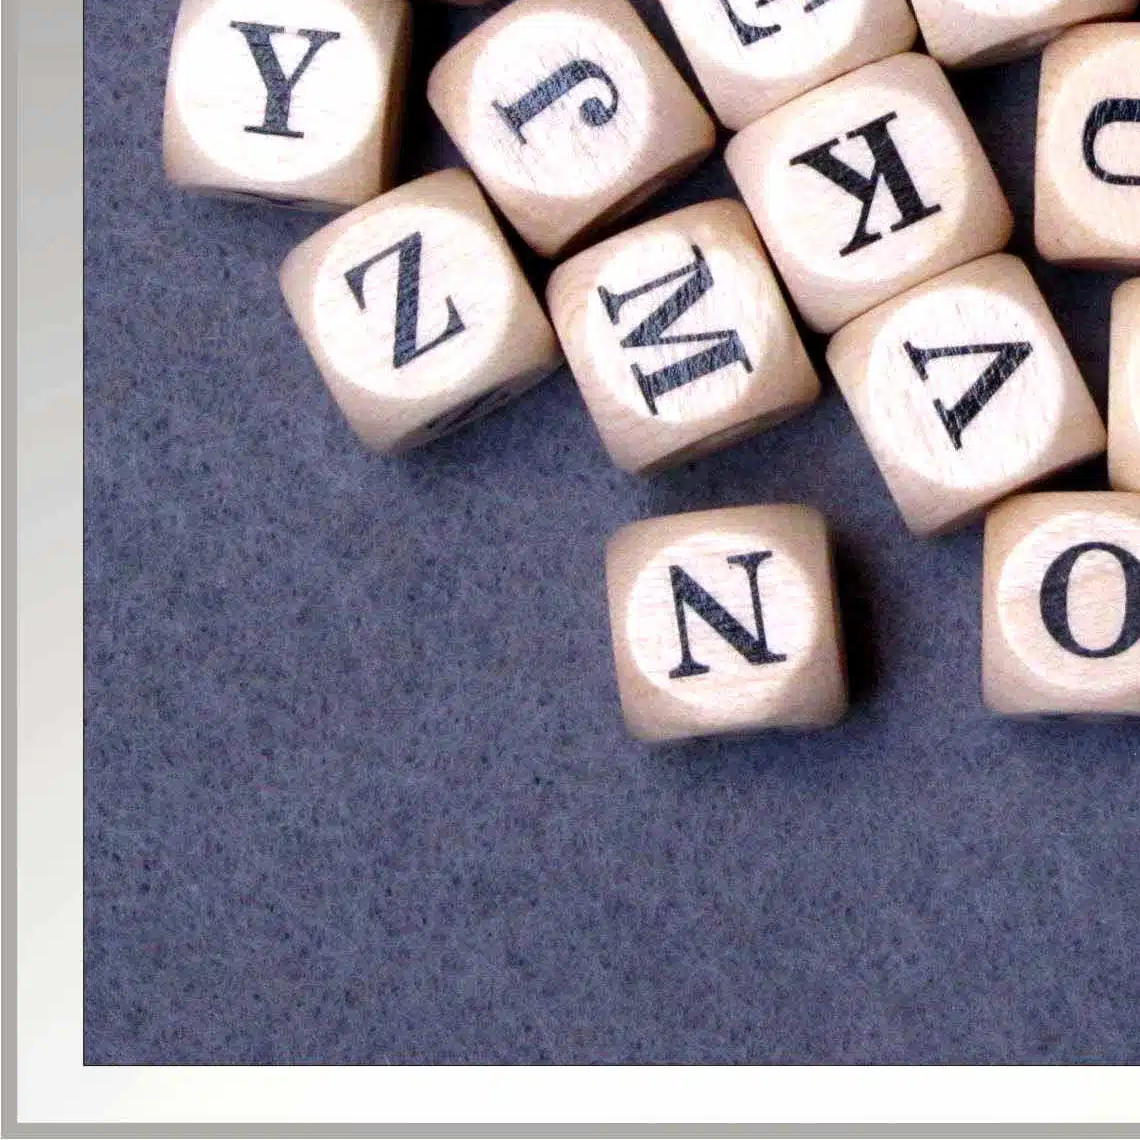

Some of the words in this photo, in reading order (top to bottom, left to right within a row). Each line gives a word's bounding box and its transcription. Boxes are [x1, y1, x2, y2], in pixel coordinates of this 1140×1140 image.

[231, 22, 340, 138] Y
[493, 60, 618, 144] J
[790, 112, 941, 257] K
[344, 232, 465, 368] Z
[597, 244, 754, 416] M
[904, 342, 1033, 450] V
[670, 551, 786, 678] N
